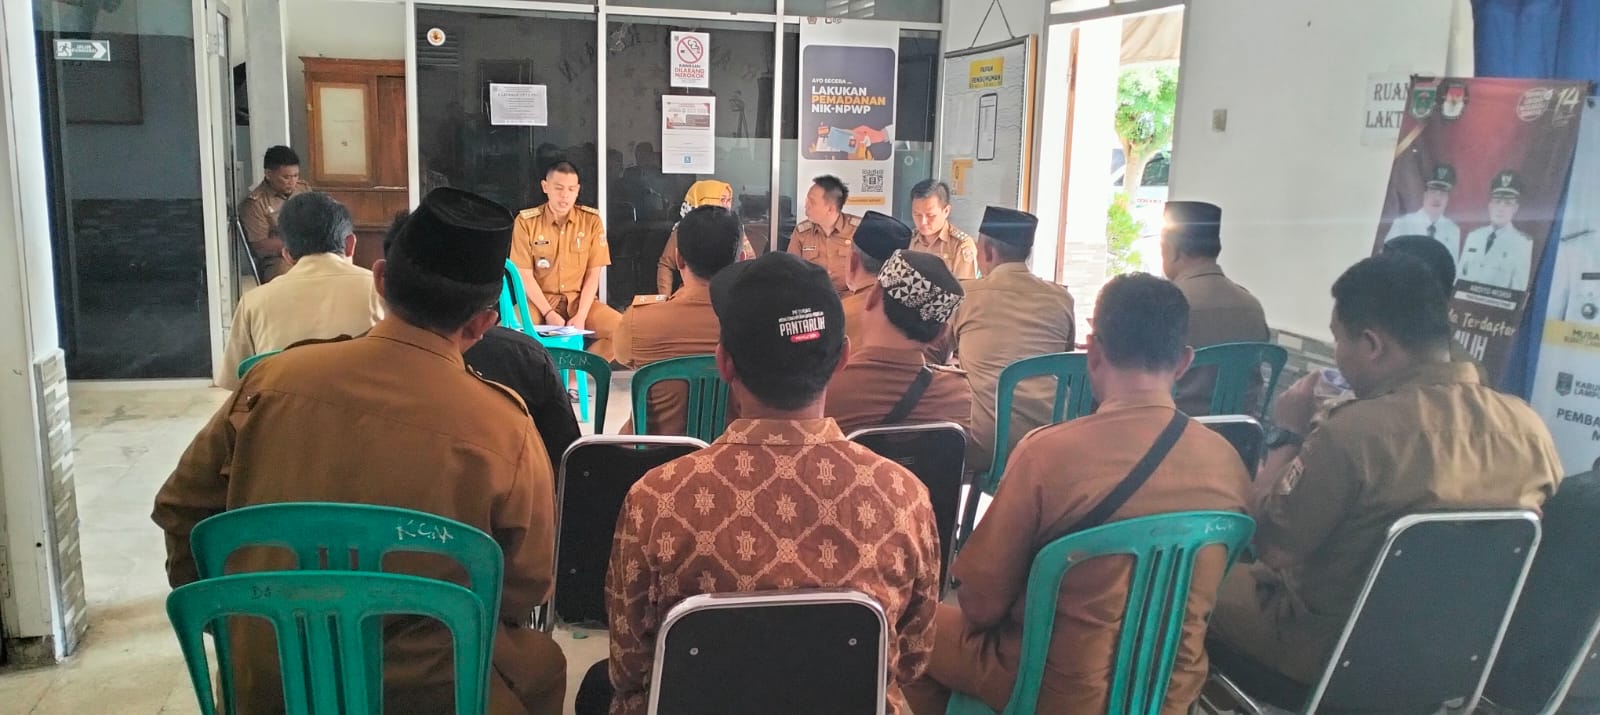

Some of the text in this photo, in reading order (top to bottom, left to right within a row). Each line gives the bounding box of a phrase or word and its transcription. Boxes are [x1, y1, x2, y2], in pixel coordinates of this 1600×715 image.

[811, 85, 867, 96] LAKUKAN
[811, 95, 886, 106] PEMADANAN
[811, 104, 871, 115] NIK-NPWP
[779, 316, 826, 337] PANTARLIH
[1462, 312, 1517, 337] Terdaftar
